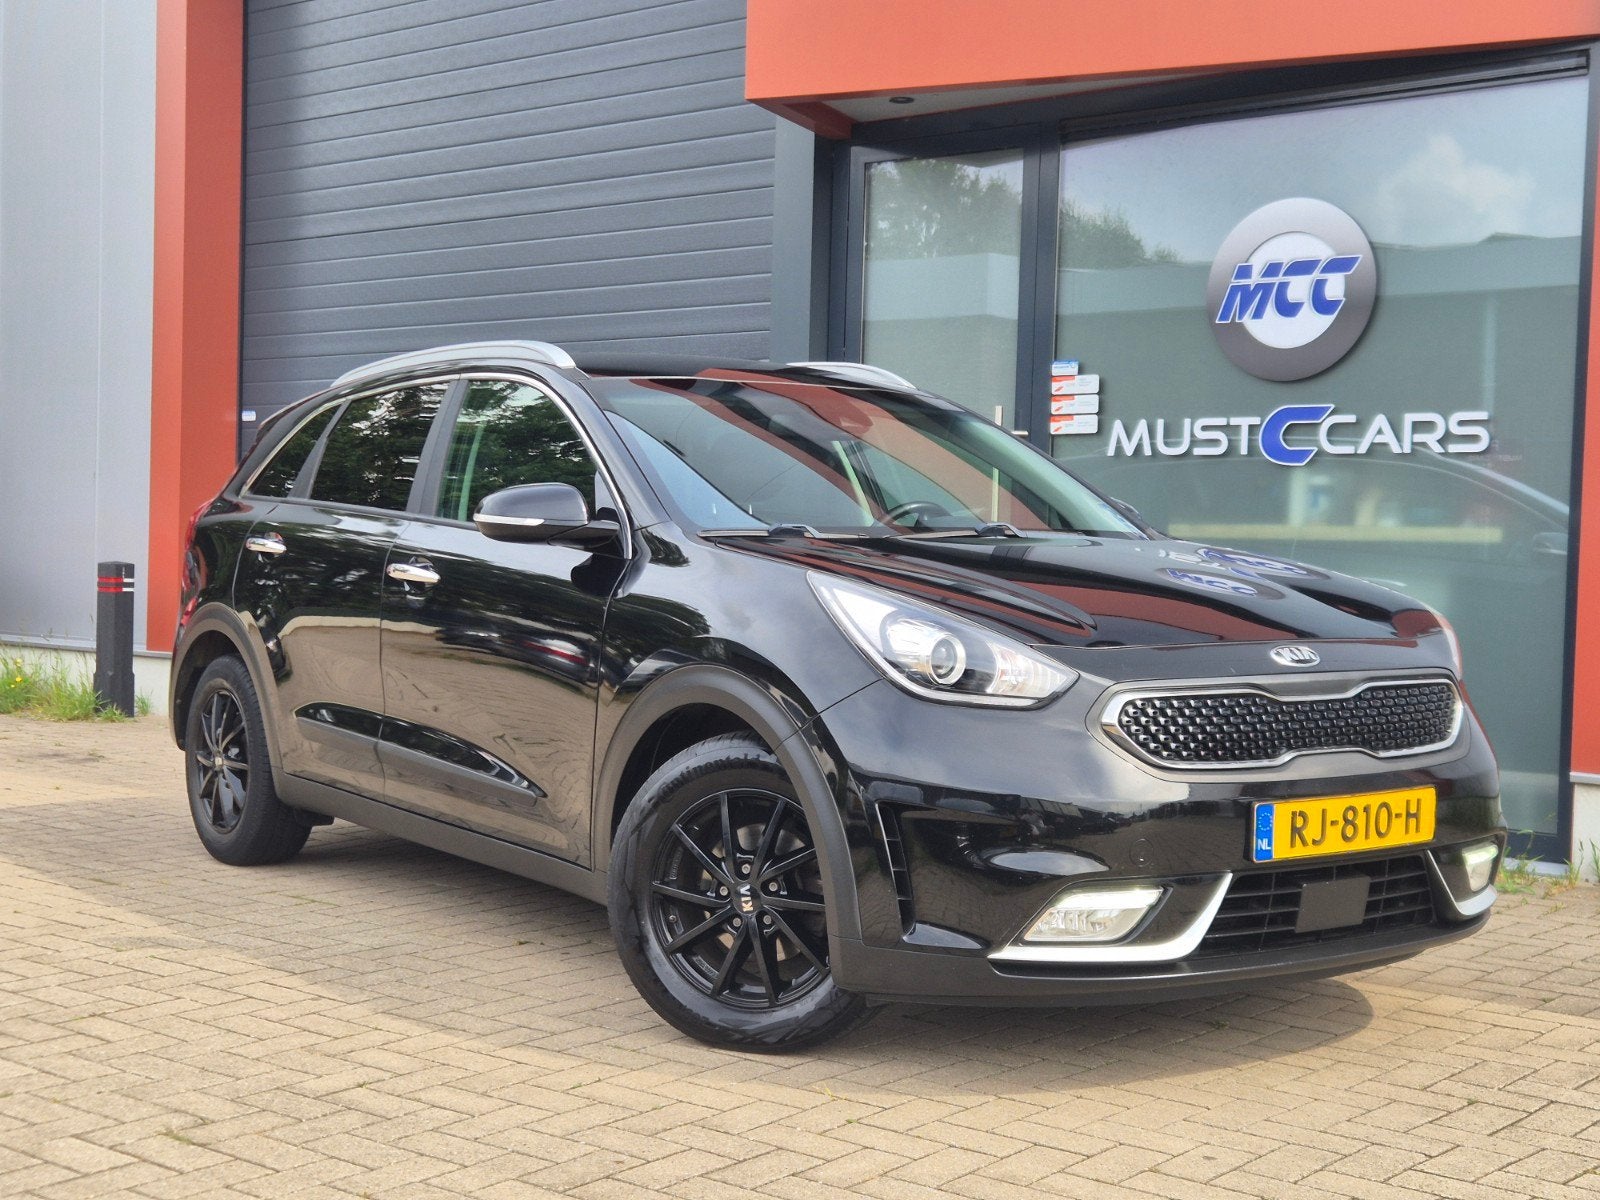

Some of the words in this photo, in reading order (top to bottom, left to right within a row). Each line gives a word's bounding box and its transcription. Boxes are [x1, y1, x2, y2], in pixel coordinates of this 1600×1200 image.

[1215, 255, 1363, 323] MCC
[1290, 798, 1422, 848] RJ-810-H
[1257, 838, 1271, 850] NL
[740, 884, 753, 912] KIA
